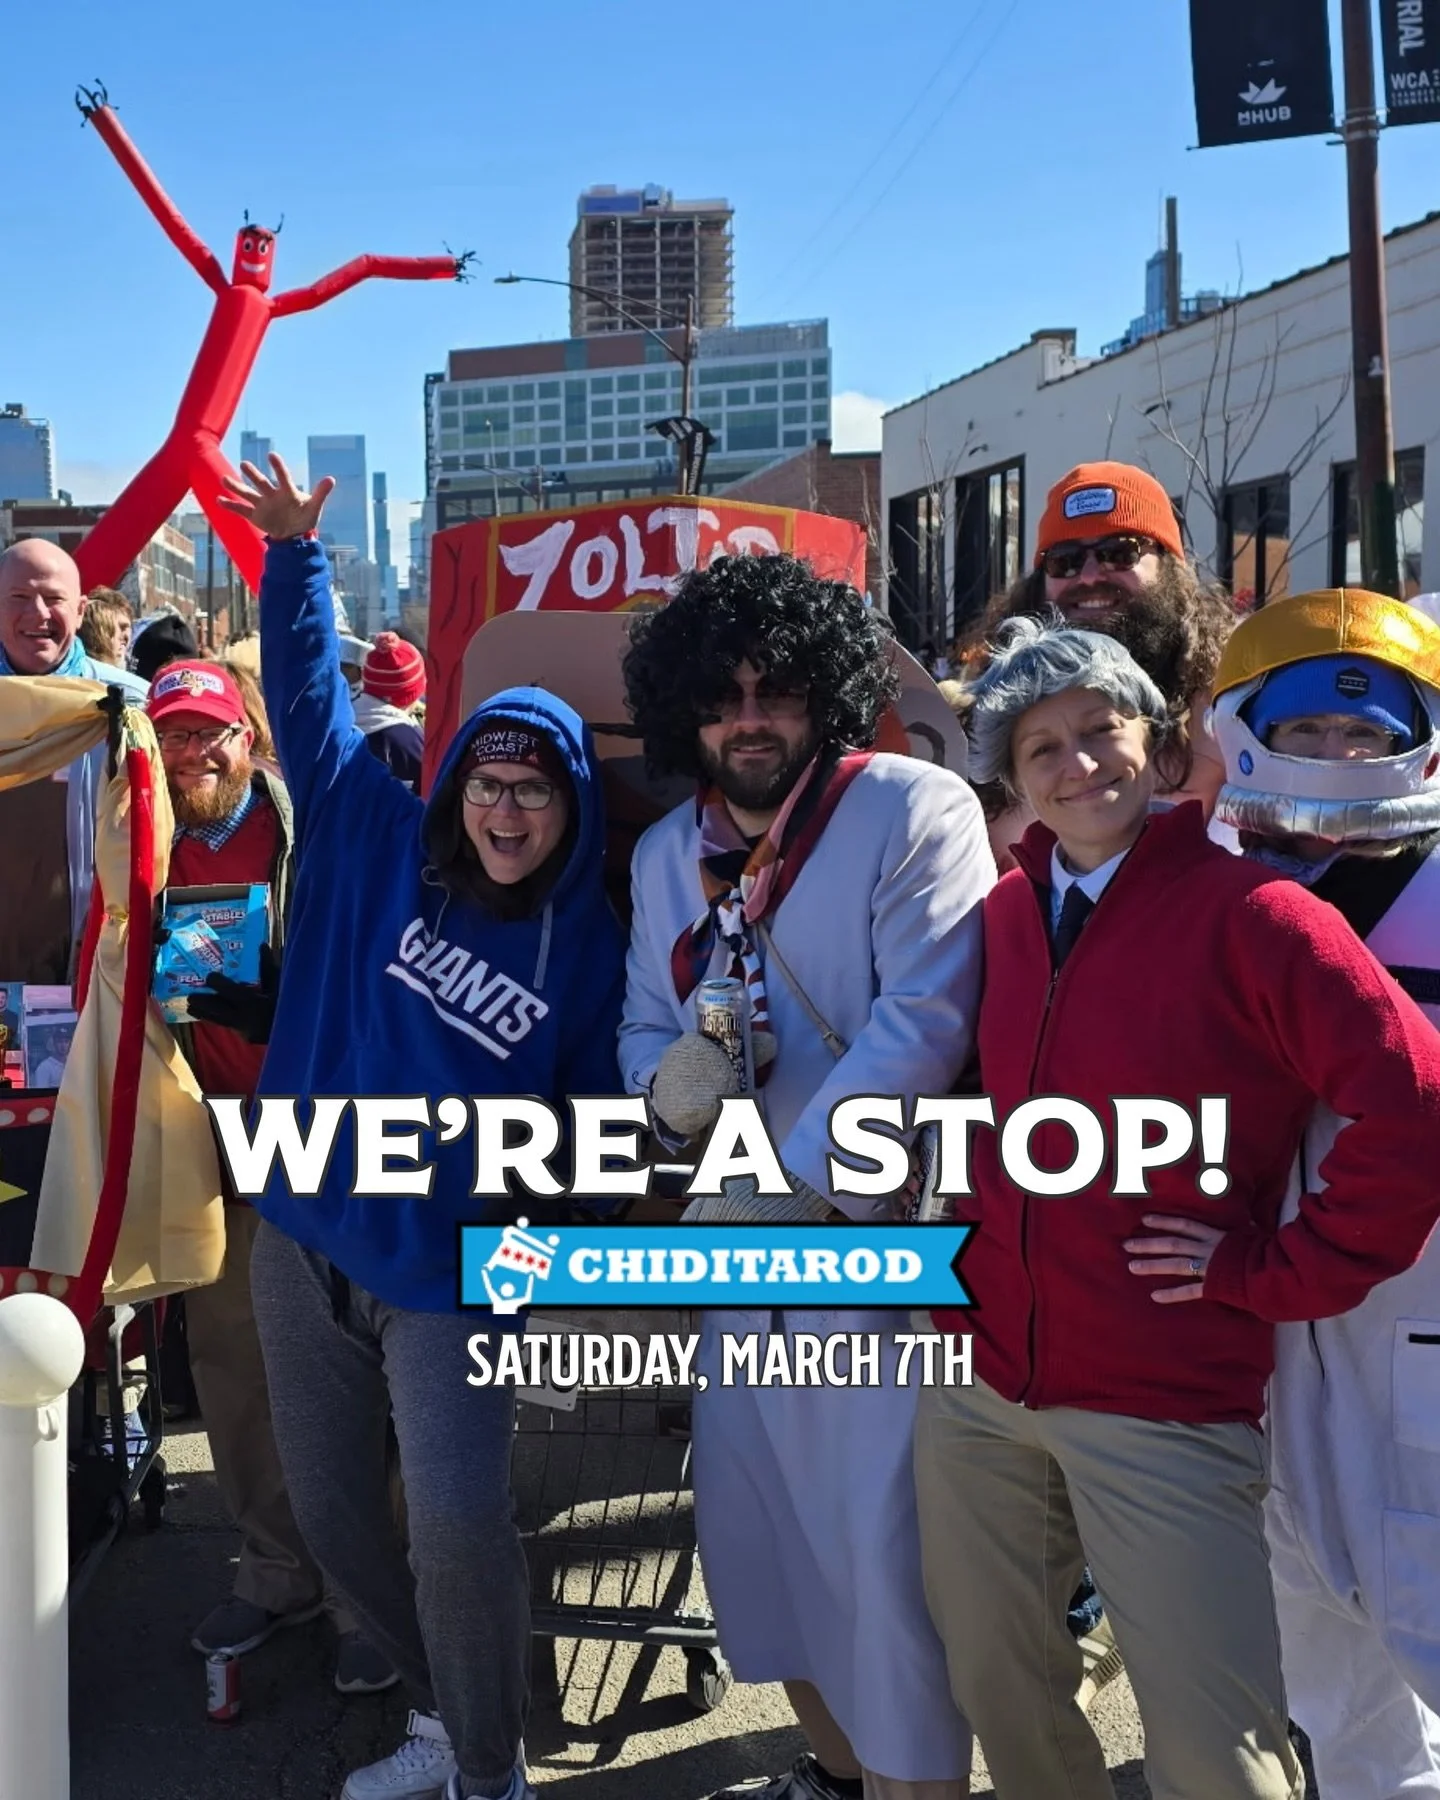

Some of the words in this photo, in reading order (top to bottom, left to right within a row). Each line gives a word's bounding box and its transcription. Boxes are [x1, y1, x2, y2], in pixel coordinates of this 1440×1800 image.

[1390, 69, 1430, 91] WCA
[476, 742, 527, 757] COAST
[398, 917, 549, 1043] GIANTS
